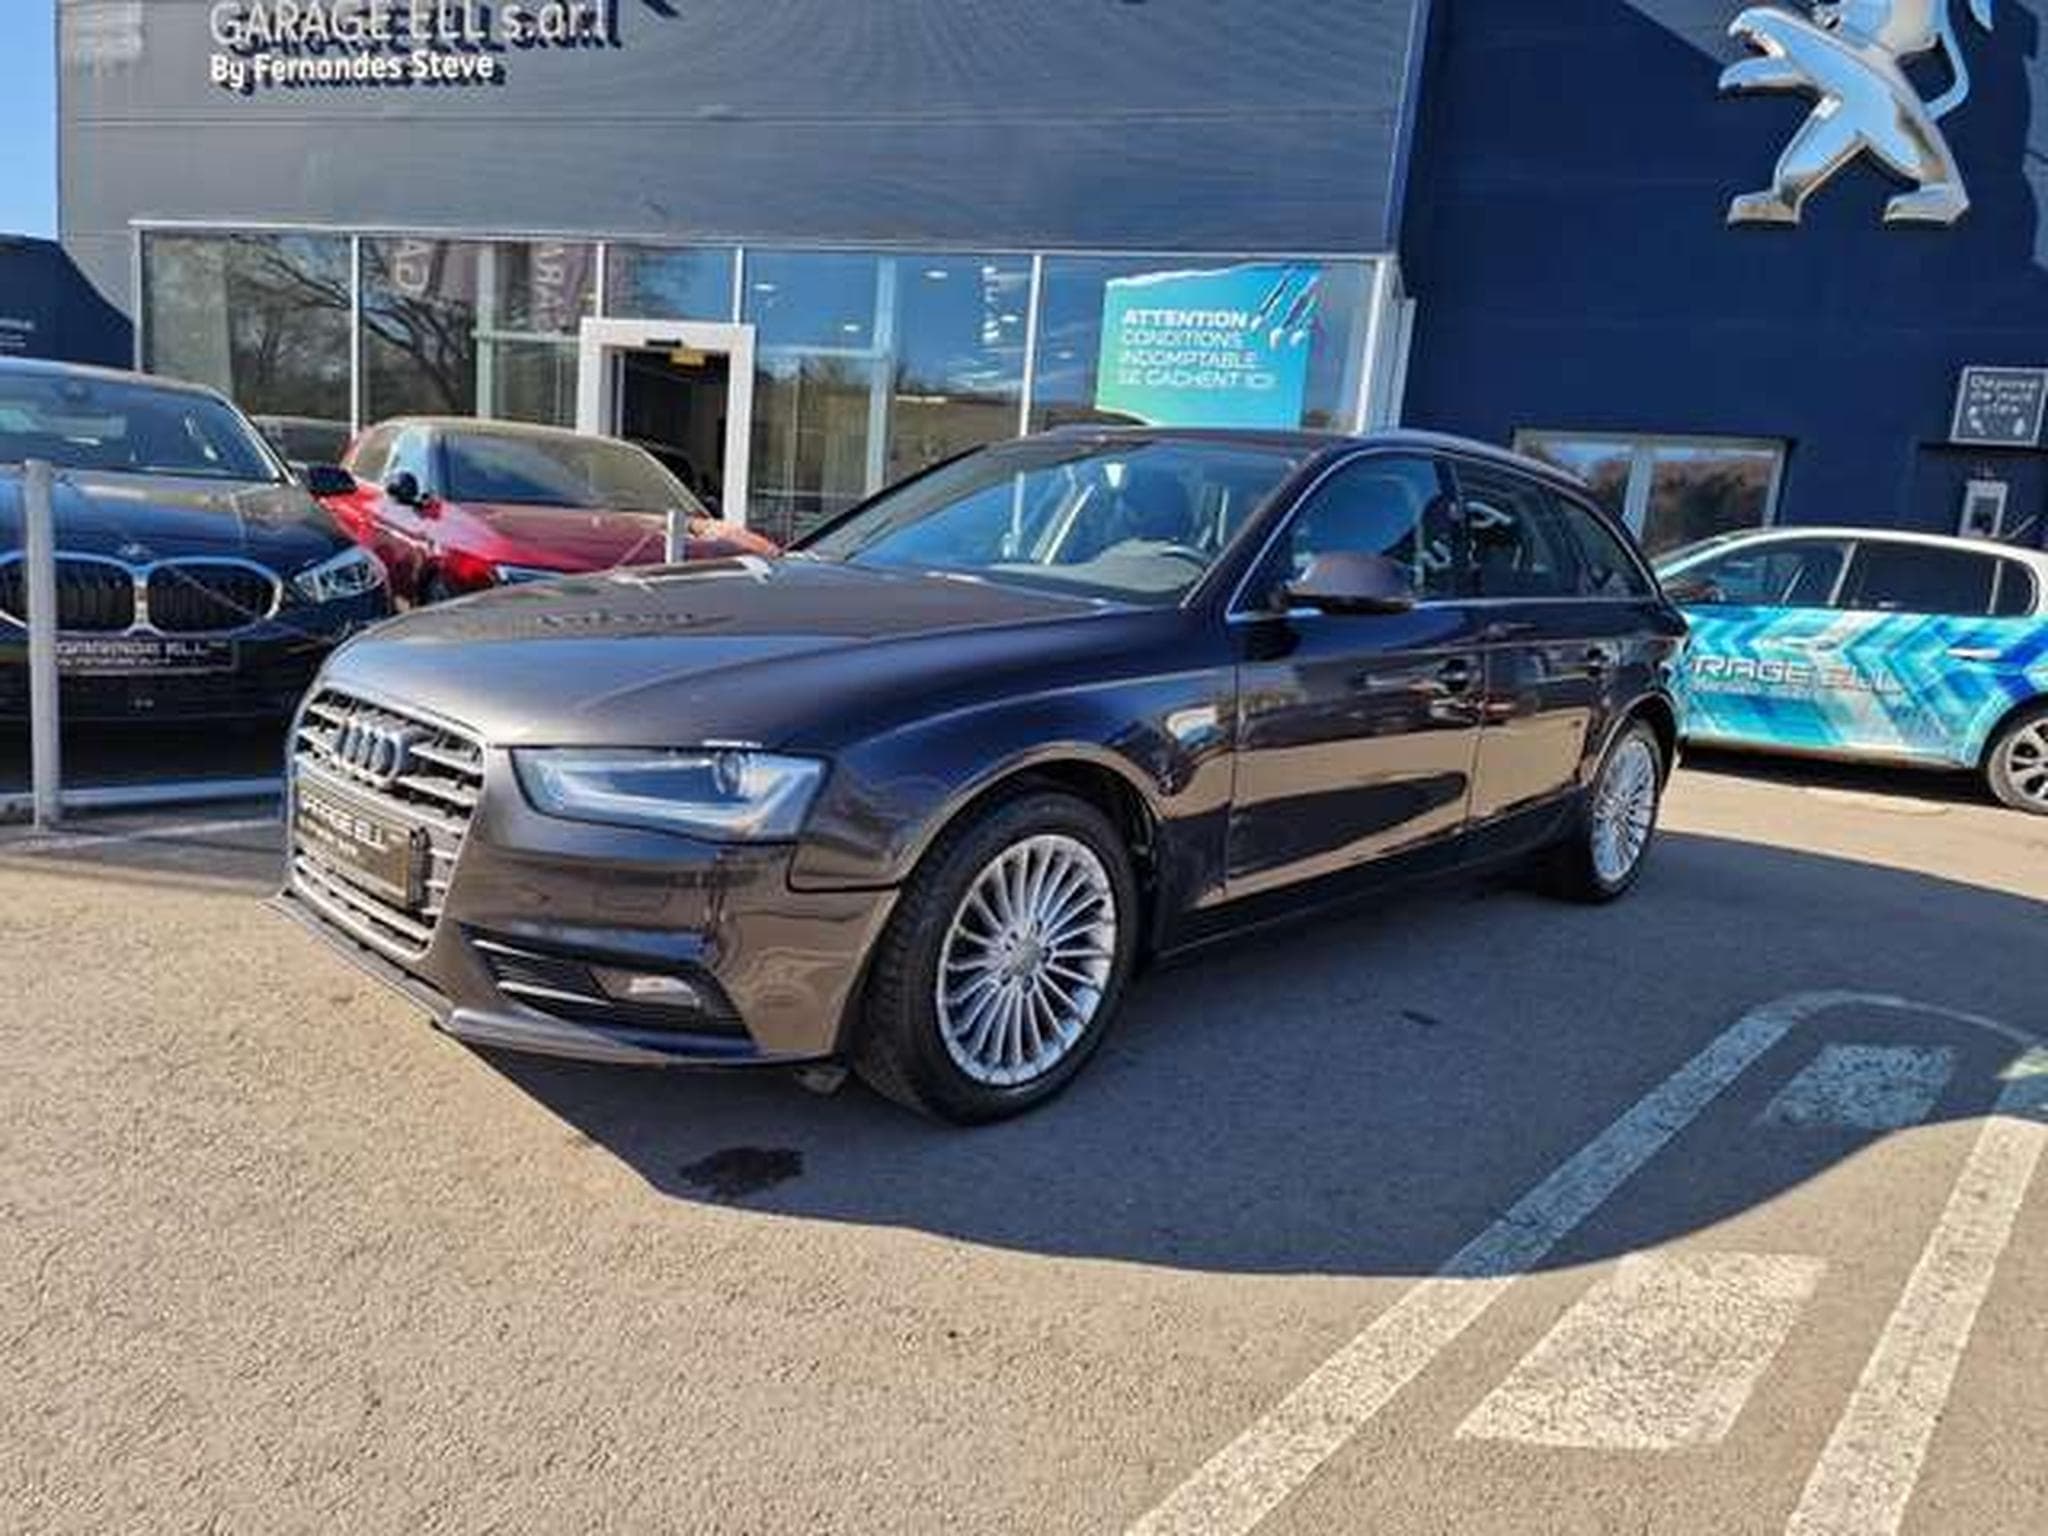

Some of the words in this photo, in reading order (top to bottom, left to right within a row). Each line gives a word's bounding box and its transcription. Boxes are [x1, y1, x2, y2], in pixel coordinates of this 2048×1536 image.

[210, 0, 392, 44] GARAGE
[409, 2, 487, 40] ELL
[210, 54, 245, 87] By
[255, 52, 402, 82] Fernandes
[411, 50, 494, 78] Steve
[1123, 309, 1248, 329] ATTENTION
[1122, 329, 1244, 348] CONDITIONS
[1692, 656, 1811, 684] RAGE
